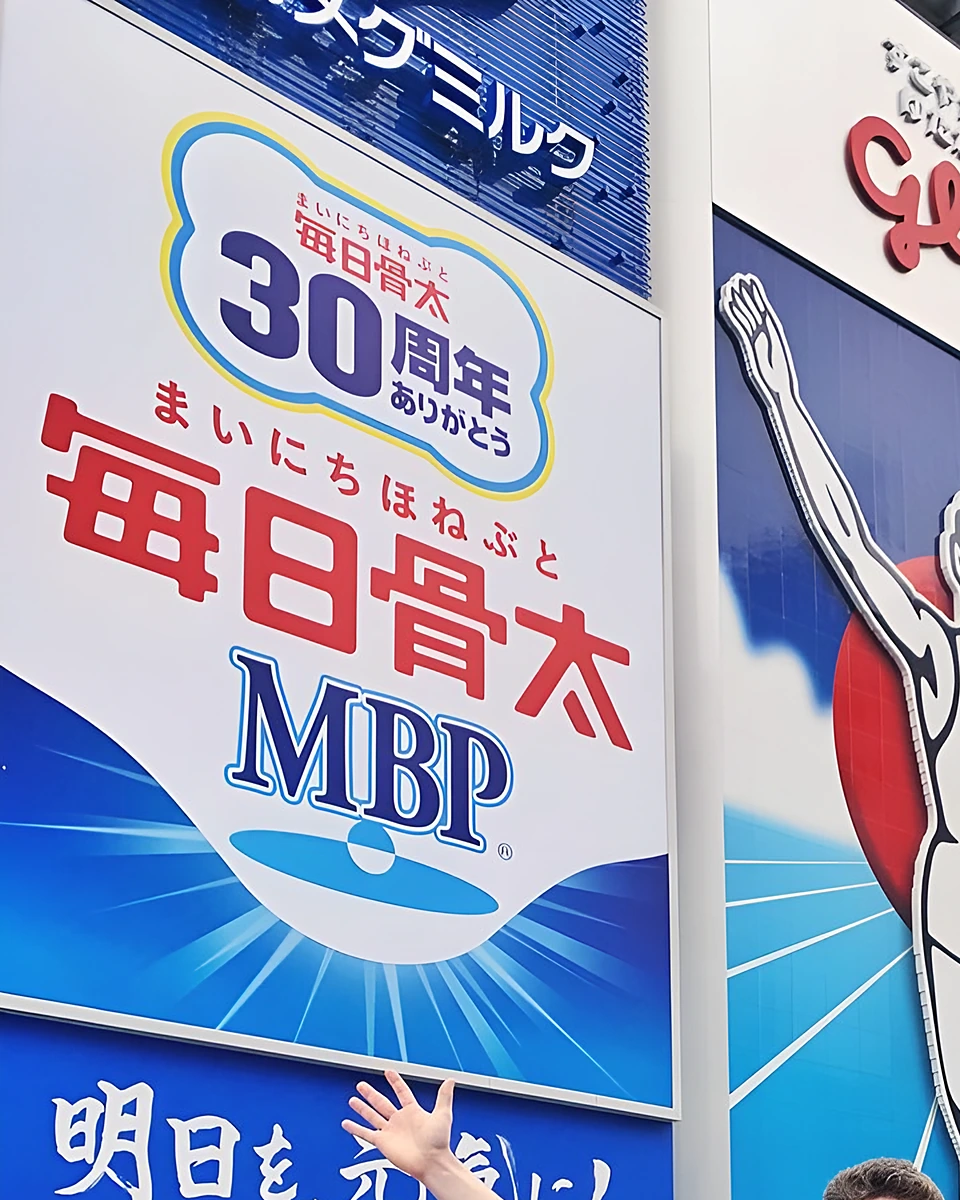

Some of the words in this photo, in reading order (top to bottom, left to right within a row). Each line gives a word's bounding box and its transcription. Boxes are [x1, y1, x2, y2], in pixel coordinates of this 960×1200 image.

[294, 208, 450, 325] 毎日骨太
[153, 379, 559, 581] まいにちほねぶと
[390, 379, 512, 458] ありがとう
[40, 393, 633, 752] 毎日骨太
[226, 647, 512, 852] MBP
